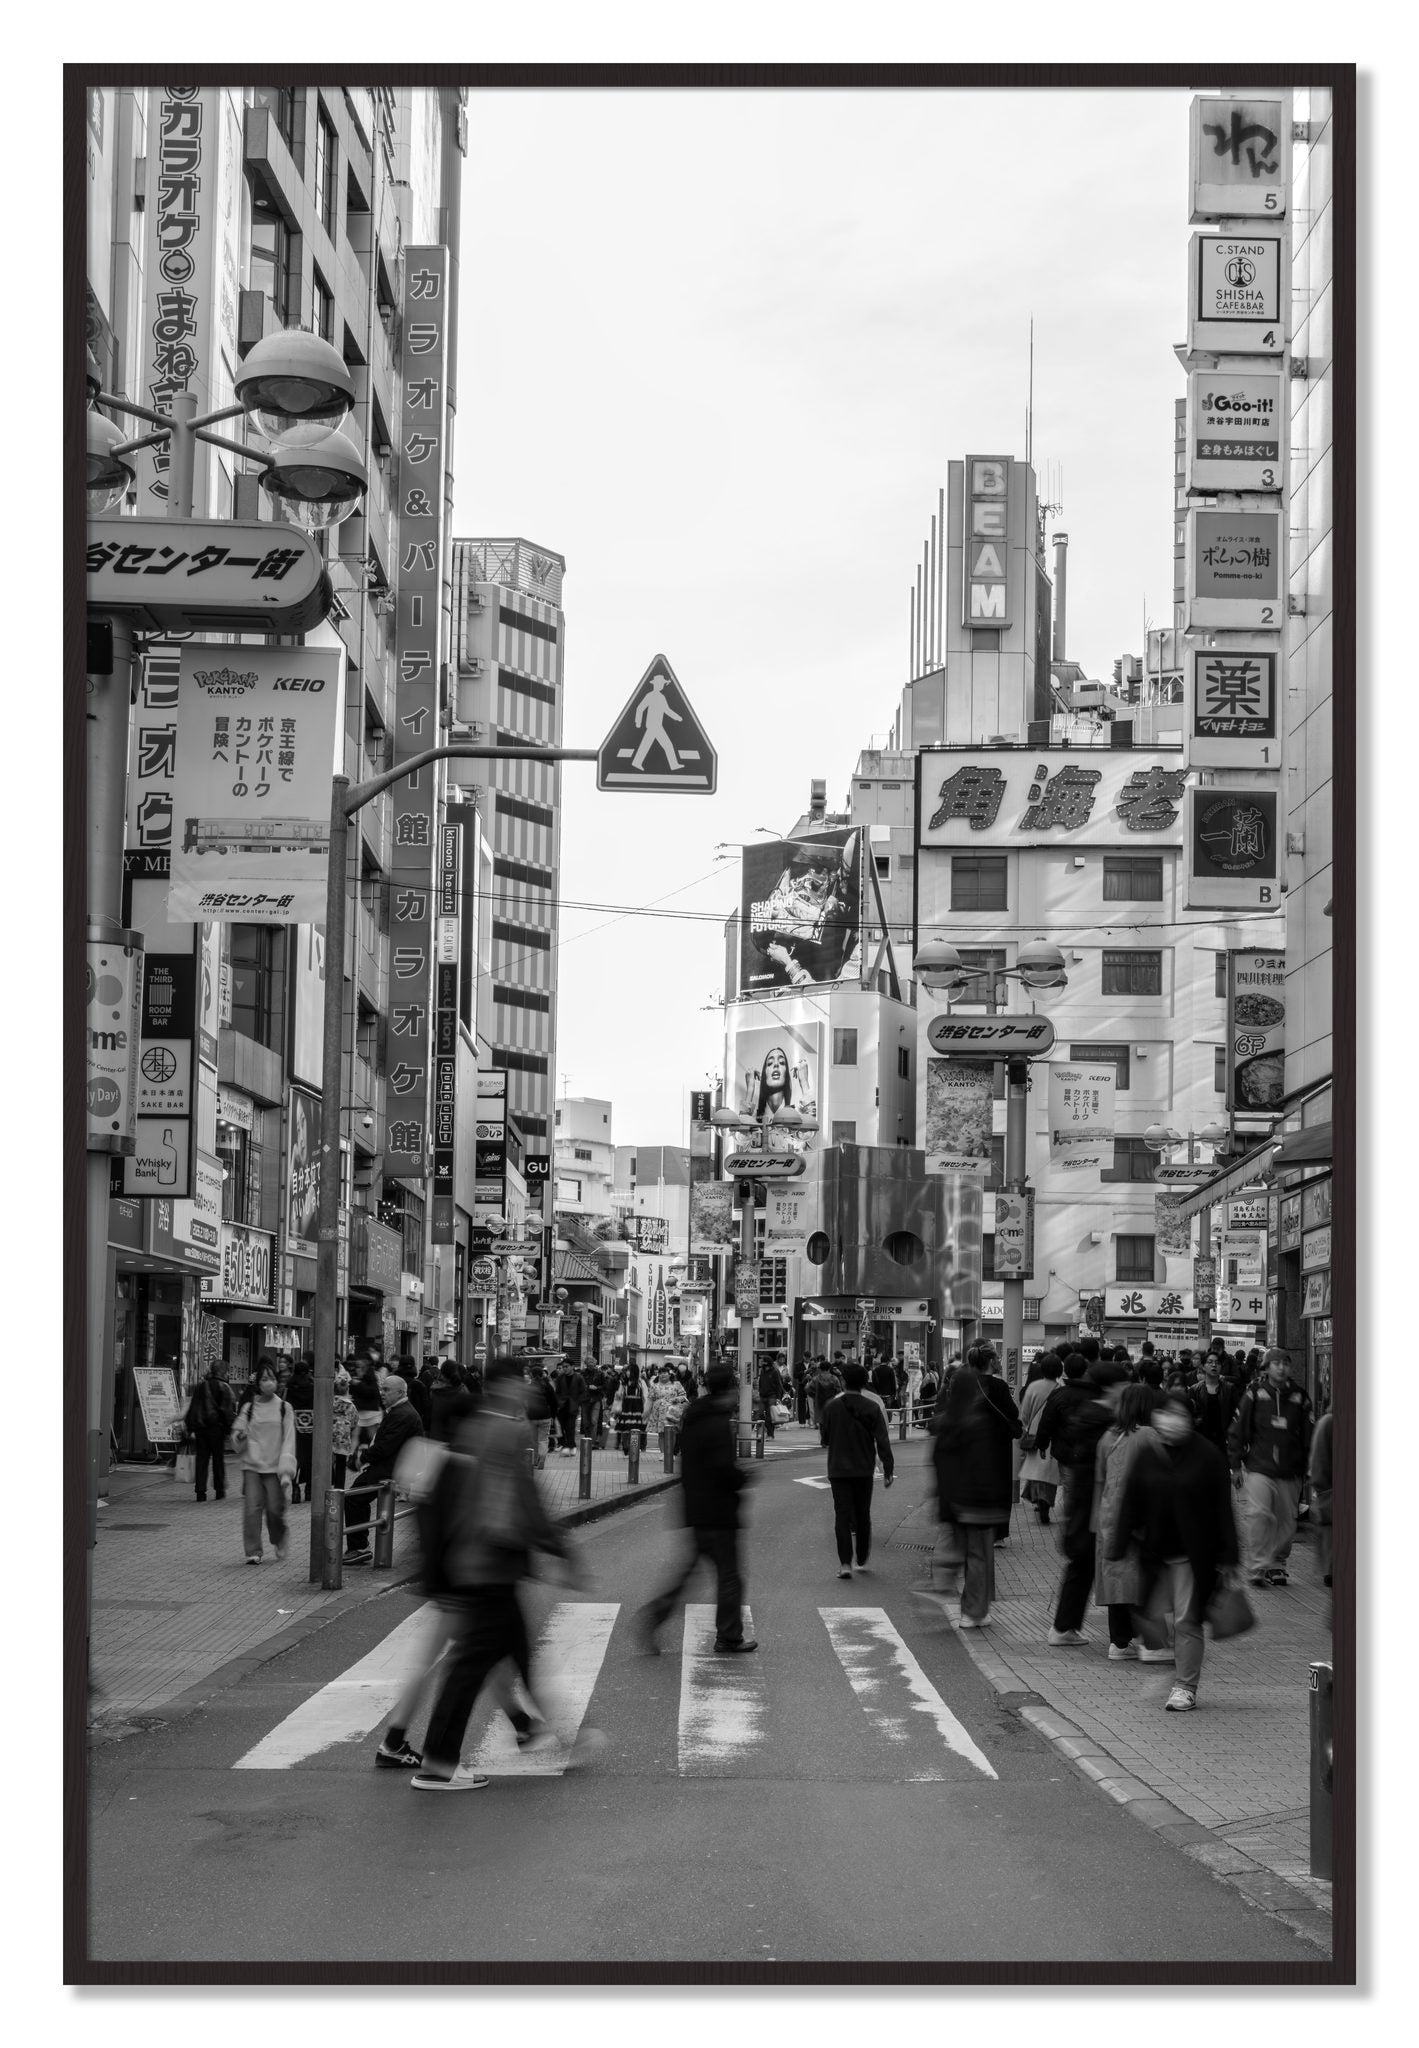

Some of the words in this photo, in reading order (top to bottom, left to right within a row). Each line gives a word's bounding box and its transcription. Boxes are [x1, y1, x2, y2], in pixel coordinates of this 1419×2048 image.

[157, 101, 202, 250] カラオケ
[1264, 194, 1277, 209] 5
[1216, 245, 1265, 255] C.STAND
[1216, 289, 1264, 300] SHISHA
[1216, 301, 1264, 310] CAFE&BAR
[1263, 331, 1276, 347] 4
[1214, 395, 1273, 412] Goo-it!
[1206, 416, 1270, 426] 渋谷宇田川町店
[1201, 444, 1275, 457] 全身もみほぐし
[1261, 469, 1274, 486] 3
[971, 461, 1007, 618] BEAM
[1202, 546, 1272, 567] ポムの樹
[1213, 572, 1263, 580] Pomme-no-ki
[1261, 607, 1274, 624] 2
[207, 687, 245, 695] KANTO
[272, 677, 326, 692] KEIO
[1206, 660, 1260, 714] 薬
[1200, 719, 1267, 734] マツモトキヨシ
[212, 716, 230, 763] 冒険へ
[232, 716, 251, 798] カントーの
[254, 716, 274, 798] ポケパーク
[278, 718, 297, 782] 京王線で
[1260, 747, 1270, 763] 1
[928, 764, 1191, 831] 角海老
[1200, 807, 1266, 860] 一蘭
[445, 829, 455, 868] kimono
[445, 874, 454, 910] hearts
[1259, 886, 1272, 902] B
[198, 893, 296, 908] 渋谷センター街
[1237, 972, 1285, 986] 四川料理
[152, 1018, 169, 1026] BAR
[388, 889, 430, 1154] カラオケ館
[935, 1025, 1048, 1039] 渋谷センター街
[1235, 1035, 1266, 1057] 6F
[97, 1088, 120, 1101] Day!
[489, 1130, 503, 1138] UP
[136, 1158, 172, 1170] Whisky
[526, 1161, 549, 1174] GU
[728, 1158, 796, 1168] 渋谷センター街
[135, 1168, 157, 1178] Bank
[1158, 1169, 1220, 1178] 渋谷センター街
[655, 1290, 665, 1335] BEER
[652, 1337, 666, 1346] HALL
